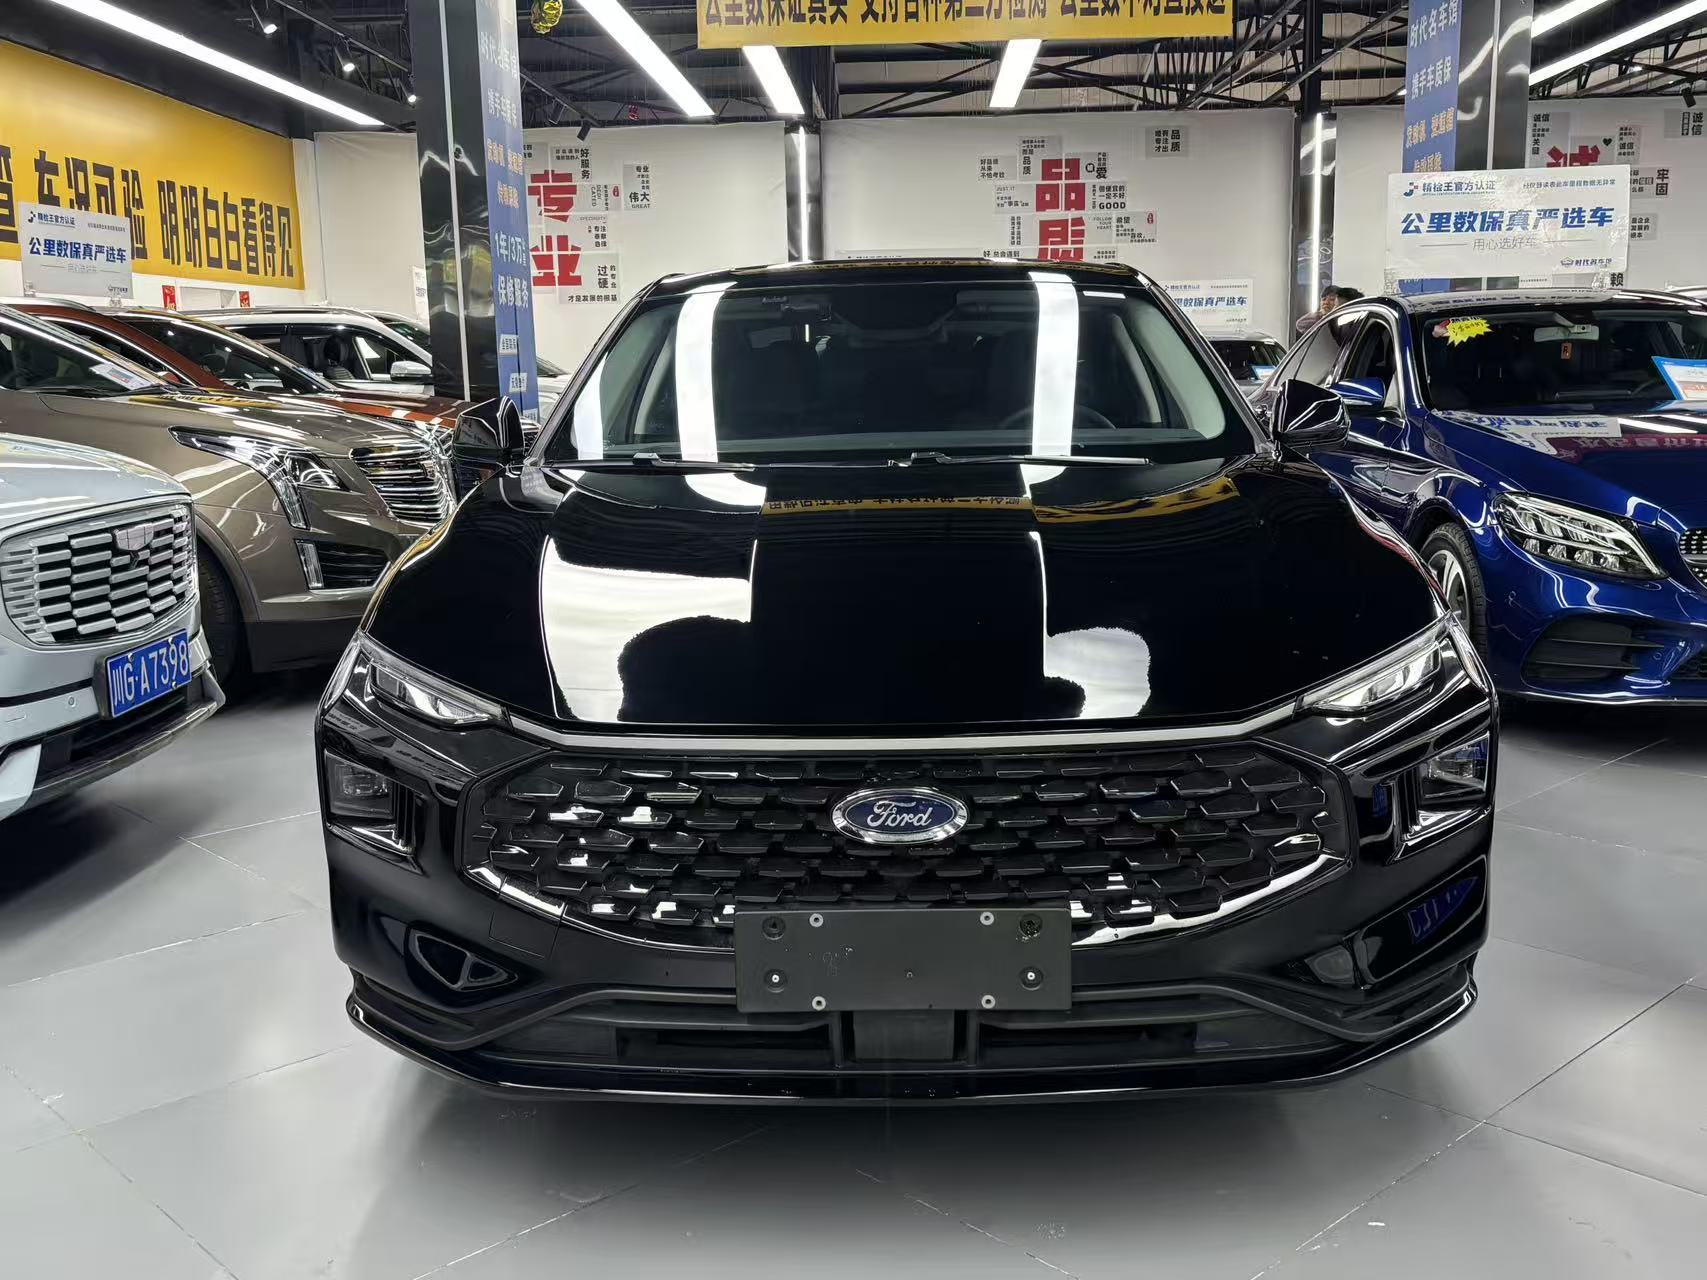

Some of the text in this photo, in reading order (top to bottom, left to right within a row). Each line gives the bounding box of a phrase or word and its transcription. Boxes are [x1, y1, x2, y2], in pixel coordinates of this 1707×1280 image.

[1410, 0, 1458, 48] 时代名车馆
[1411, 56, 1452, 100] 携手车质保
[1690, 111, 1704, 137] 诚信
[1170, 129, 1181, 152] 品质
[580, 148, 591, 180] 好服务
[1095, 167, 1107, 179] 爱
[1422, 181, 1496, 193] 精检王官方认证
[1655, 168, 1670, 196] 牢固
[629, 191, 650, 203] 伟大
[1098, 201, 1127, 210] GOOD
[157, 179, 294, 278] 明明白白看得见
[1400, 206, 1615, 235] 公里数保真严选车
[28, 236, 128, 264] 公里数保真严选车
[1472, 236, 1538, 251] 用心选好车
[597, 265, 609, 289] 过硬
[866, 800, 933, 827] Ford
